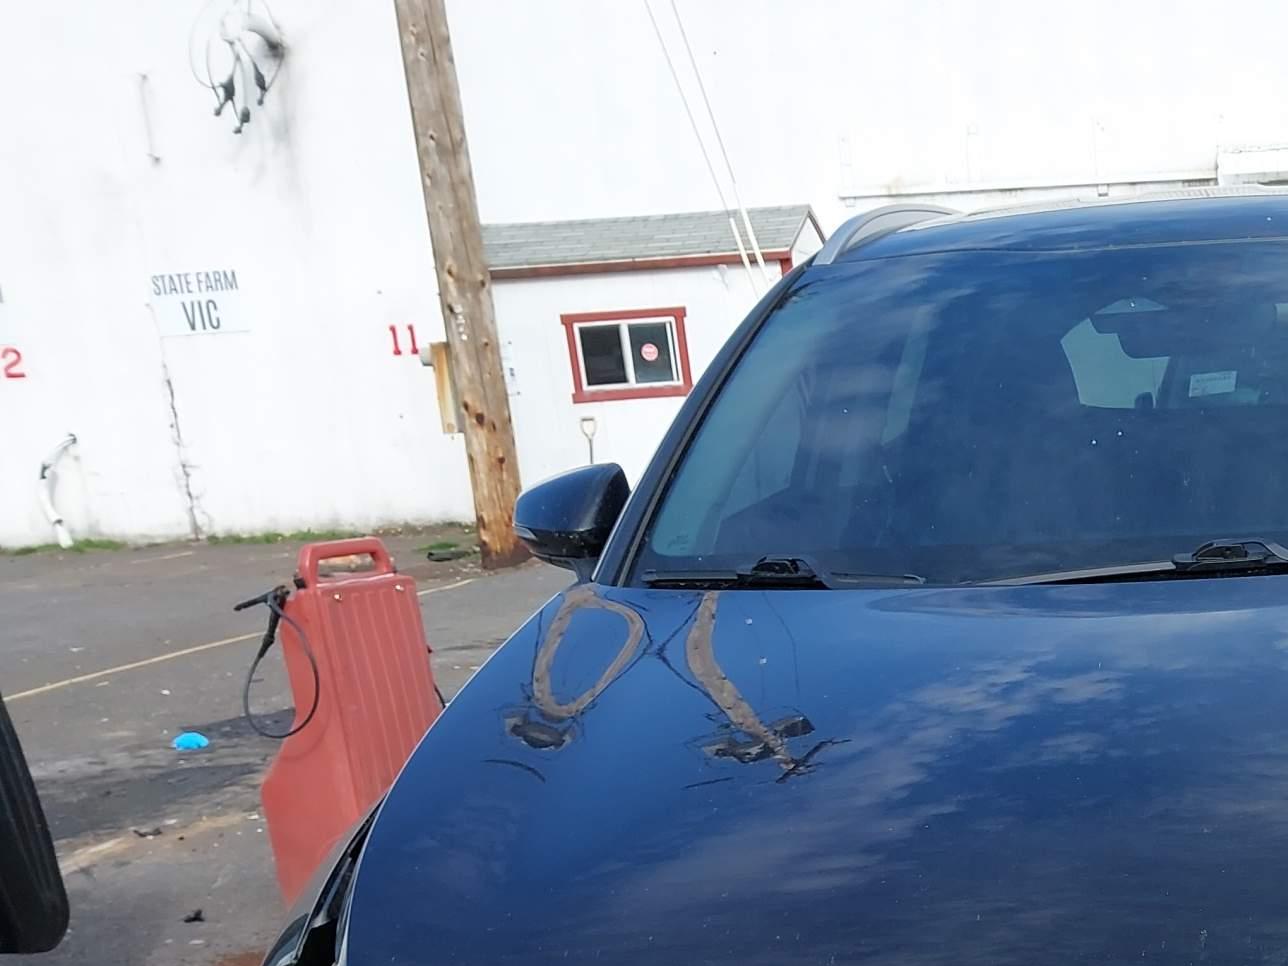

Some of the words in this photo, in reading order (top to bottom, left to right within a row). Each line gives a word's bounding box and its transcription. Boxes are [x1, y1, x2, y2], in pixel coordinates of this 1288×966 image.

[151, 272, 193, 296] STATE
[196, 269, 239, 293] FARM
[181, 299, 220, 331] VIC
[389, 324, 418, 355] 11
